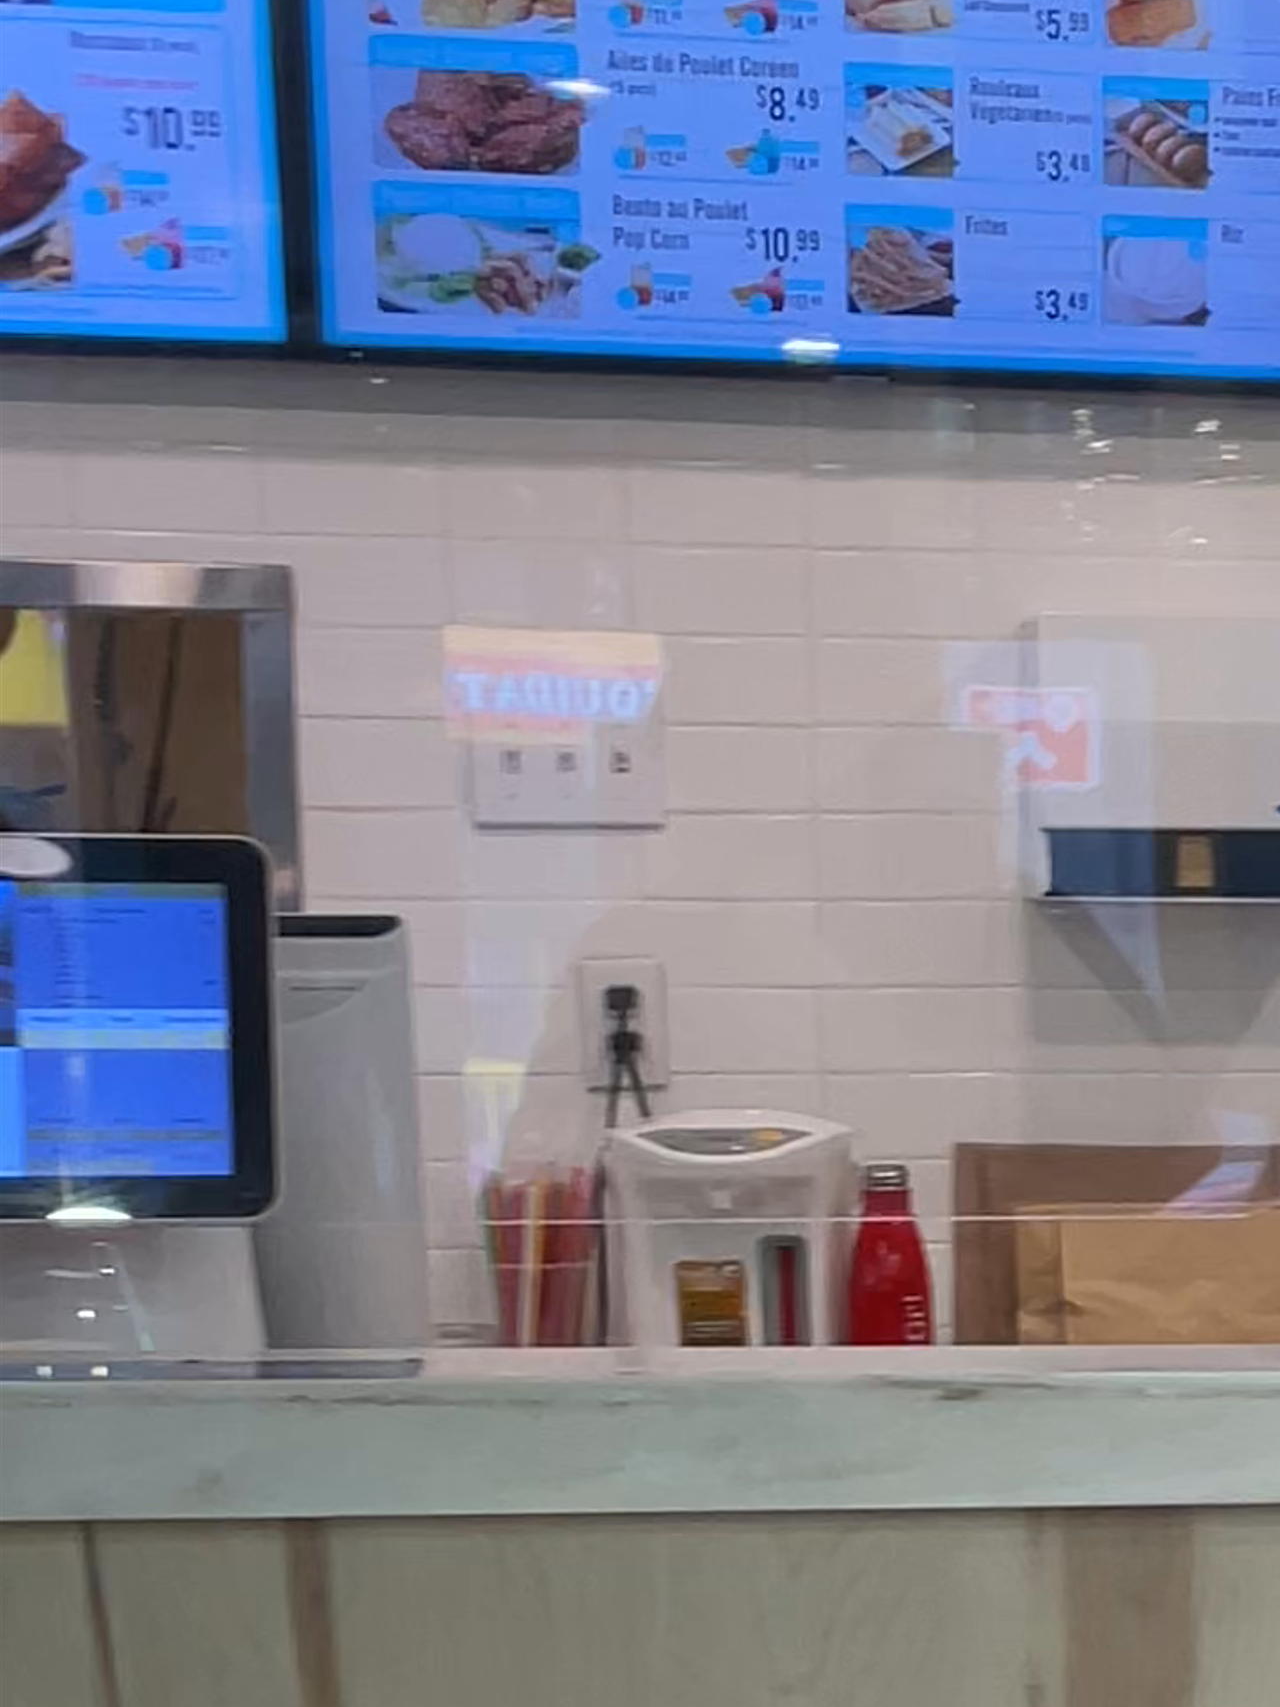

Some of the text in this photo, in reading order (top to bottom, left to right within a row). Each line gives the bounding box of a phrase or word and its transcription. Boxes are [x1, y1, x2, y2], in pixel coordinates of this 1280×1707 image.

[1036, 9, 1090, 41] $5.99
[756, 85, 820, 123] $8.49
[746, 227, 820, 263] $10.99
[1035, 289, 1089, 321] $3.49
